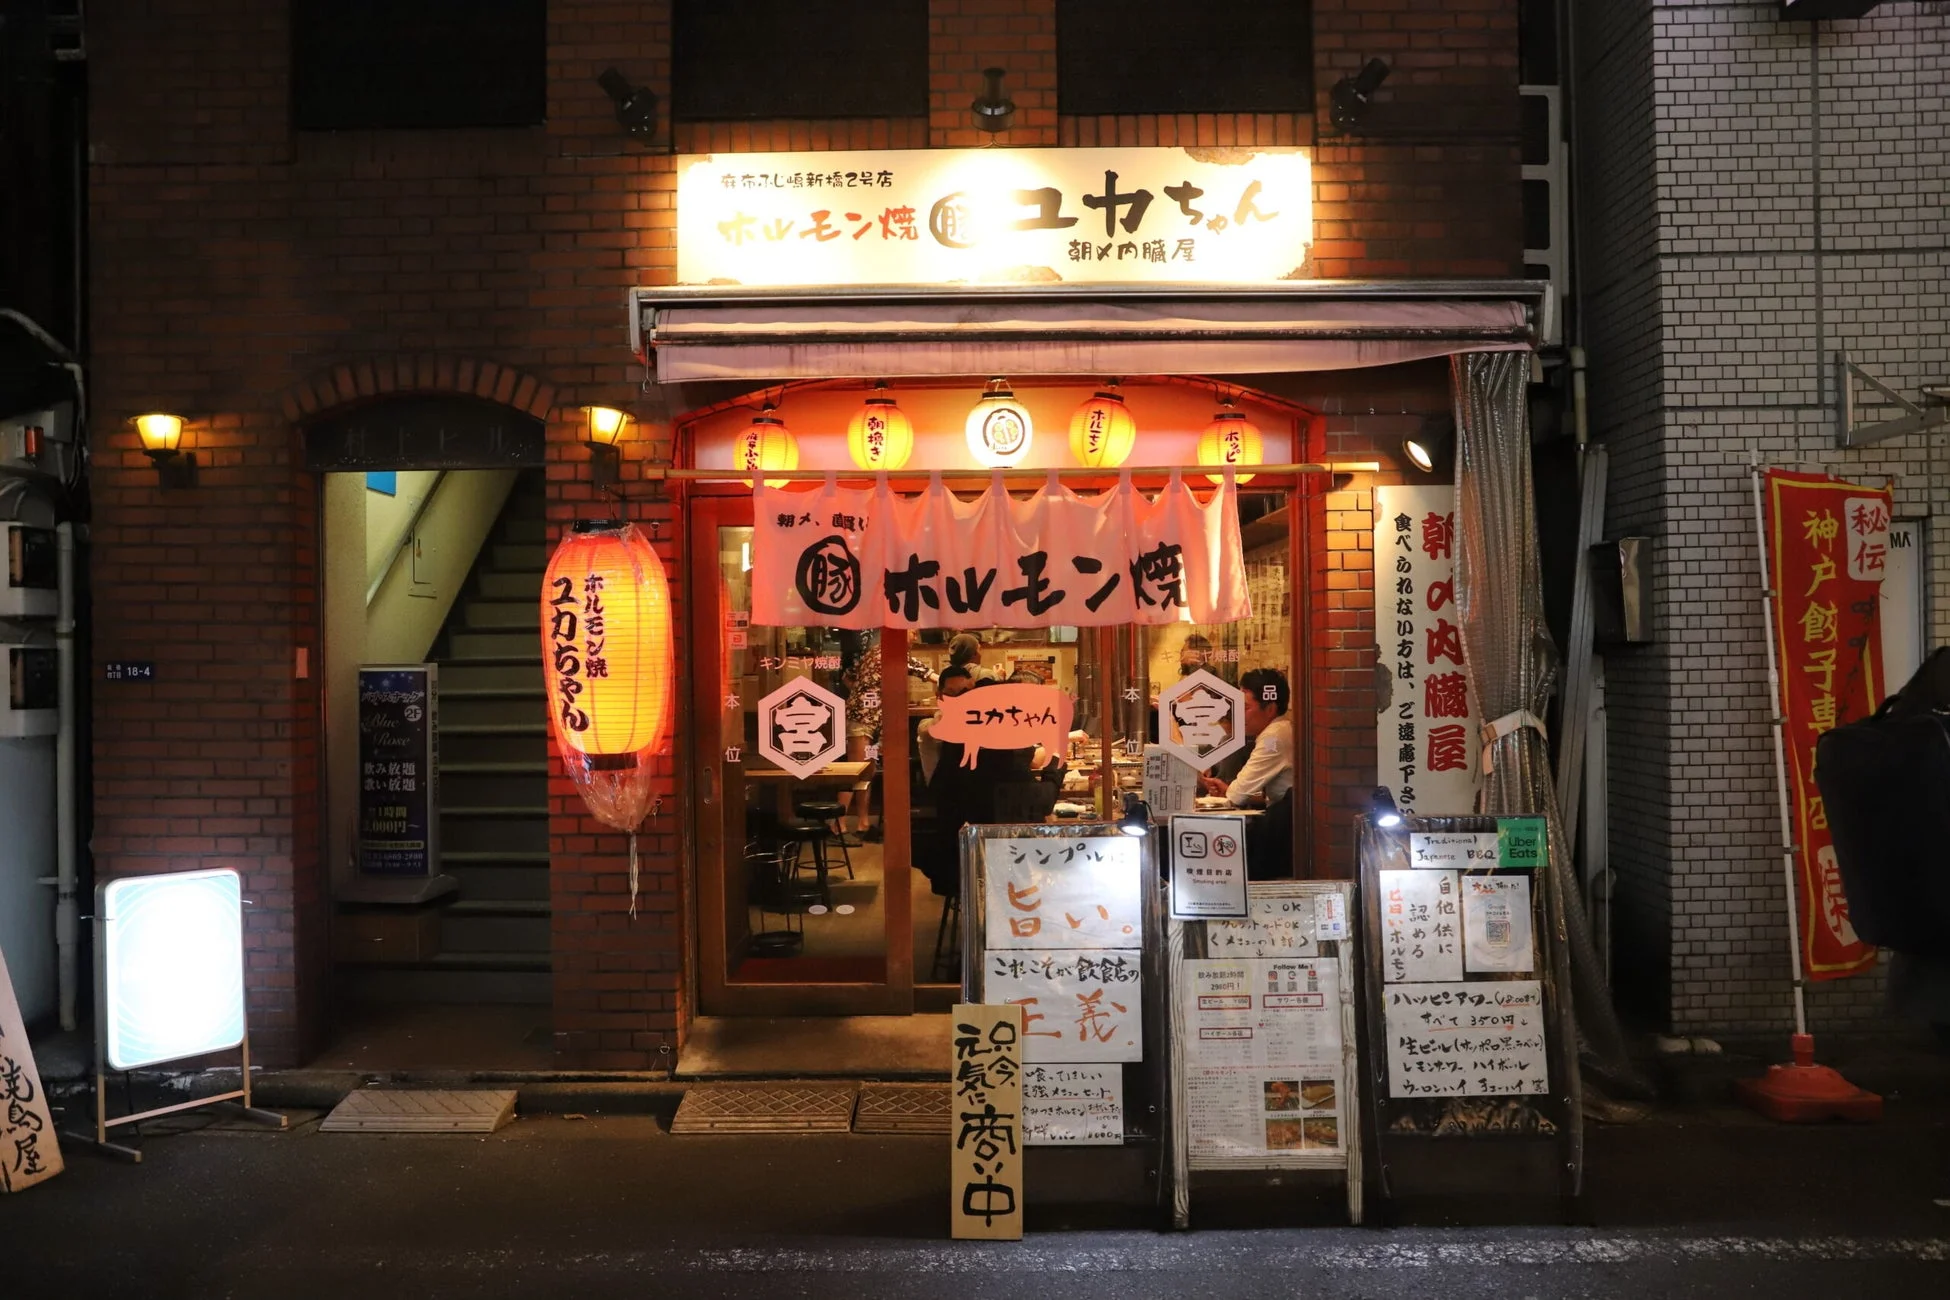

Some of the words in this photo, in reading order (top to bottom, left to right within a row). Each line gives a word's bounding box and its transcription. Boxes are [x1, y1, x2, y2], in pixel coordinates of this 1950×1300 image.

[1010, 168, 1279, 238] ユカちゃん
[717, 204, 919, 246] ホルモン焼
[867, 416, 885, 462] 朝挽き
[1089, 409, 1105, 453] ホルモン
[1851, 502, 1888, 572] 秘伝
[884, 542, 1187, 622] ホルモン焼
[584, 574, 608, 678] ホルモン焼
[550, 576, 590, 732] ユカちゃん
[760, 656, 842, 671] キンミヤ焼酎
[127, 666, 151, 677] 18-4
[406, 709, 421, 719] 2F
[965, 706, 1057, 728] ユカちゃん
[1467, 849, 1496, 860] BBQ
[1509, 836, 1536, 847] Uber
[1509, 849, 1537, 858] Eats
[1008, 882, 1133, 938] 旨い。
[1282, 902, 1302, 912] OK
[1408, 903, 1431, 959] 認める
[995, 956, 1139, 983] これこそが飲食店の
[1421, 1012, 1458, 1026] すべて
[1471, 1015, 1514, 1026] 350円
